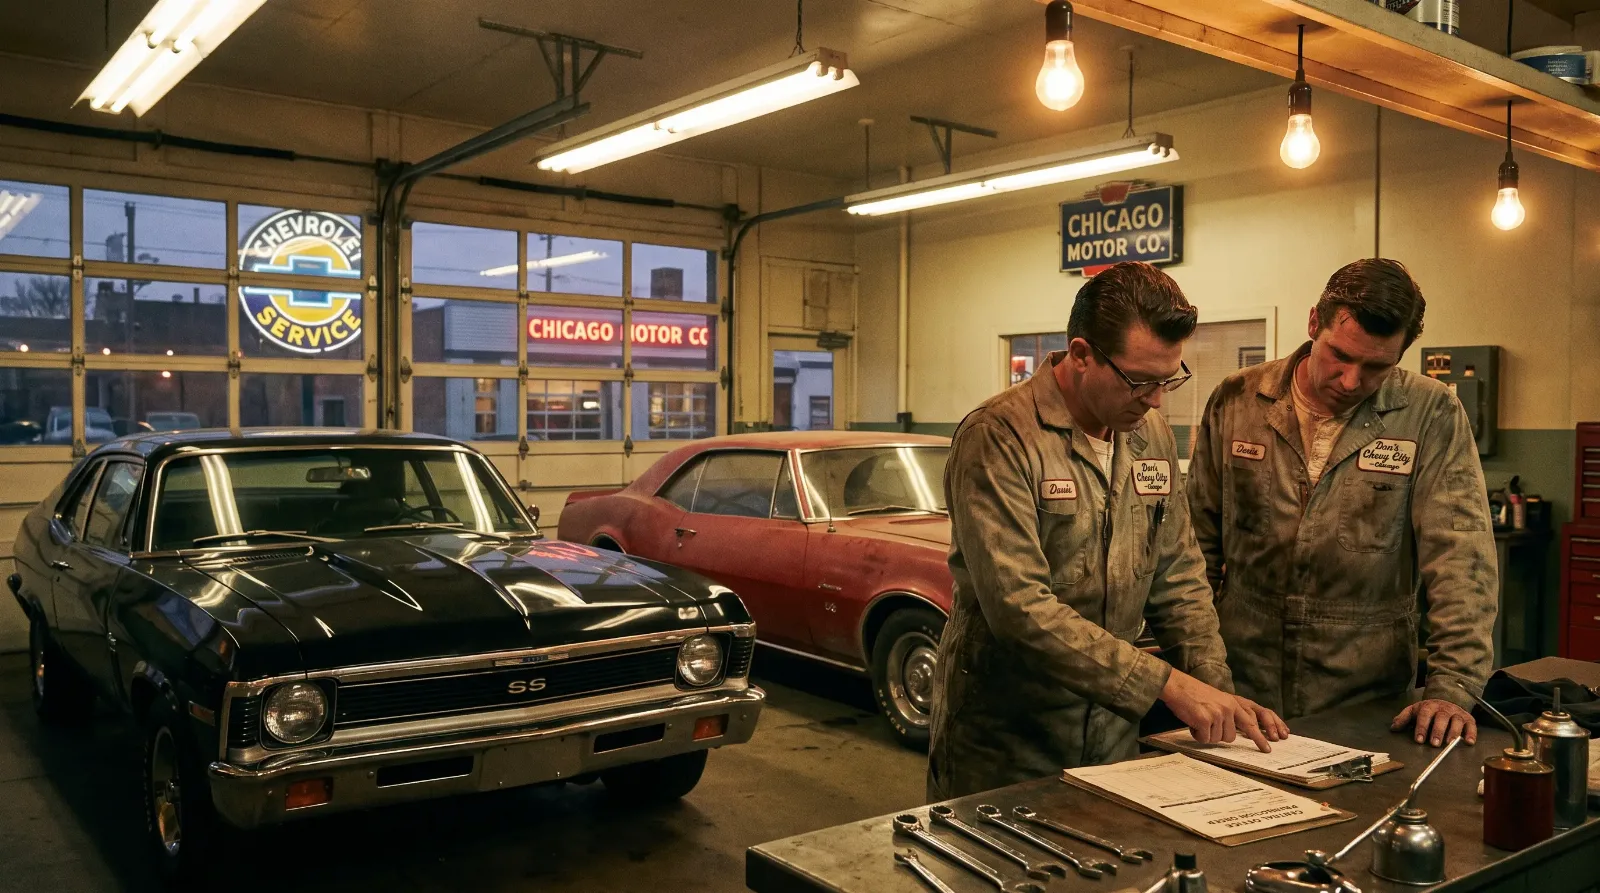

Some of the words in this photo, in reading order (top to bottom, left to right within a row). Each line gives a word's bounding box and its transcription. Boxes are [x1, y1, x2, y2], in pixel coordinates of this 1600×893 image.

[1068, 203, 1164, 238] CHICAGO
[1067, 237, 1128, 262] MOTOR
[1135, 233, 1166, 254] CO.
[257, 306, 361, 347] SERVICE
[528, 318, 614, 342] CHICAGO
[1362, 449, 1389, 463] Chevy
[507, 677, 546, 694] SS
